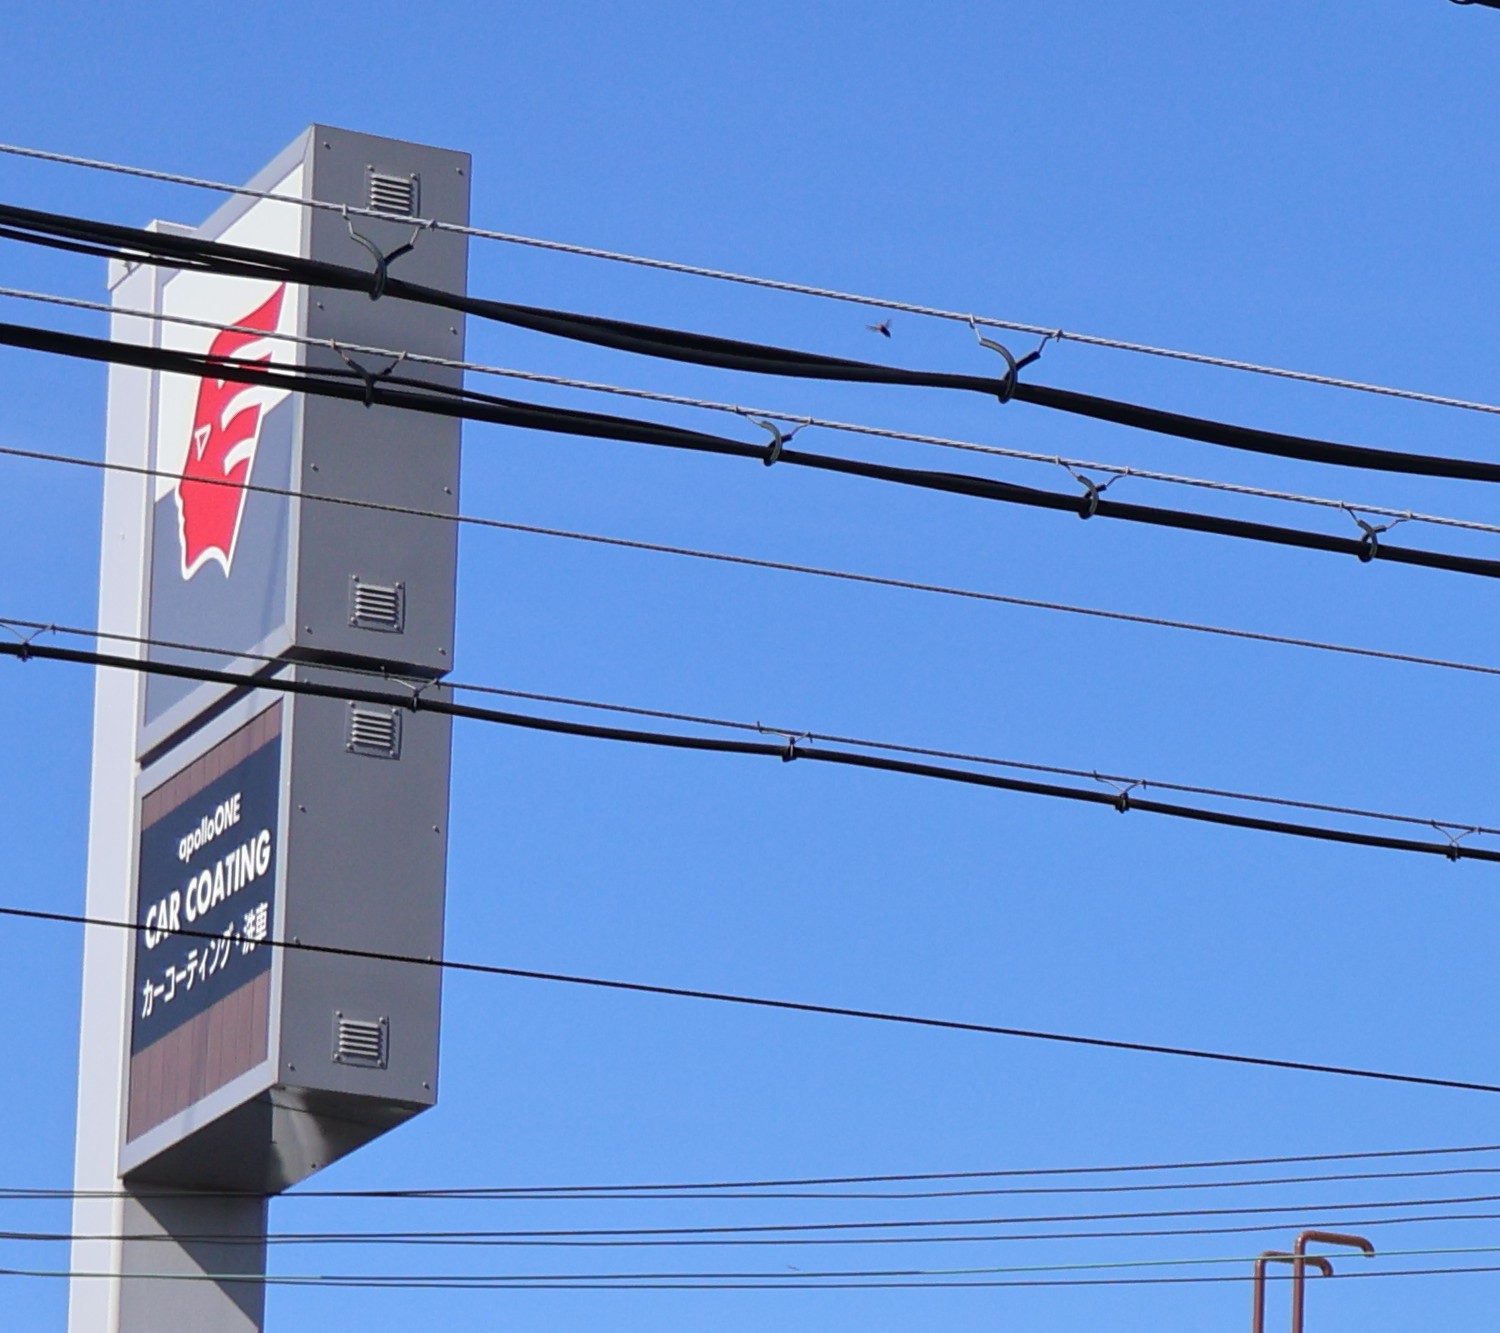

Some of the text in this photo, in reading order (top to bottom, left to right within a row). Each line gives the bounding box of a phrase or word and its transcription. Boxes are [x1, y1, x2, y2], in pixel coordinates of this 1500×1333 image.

[178, 793, 242, 863] apolloONE
[145, 829, 270, 949] CAR COATING
[141, 902, 269, 1018] カーコーティング・洗車
